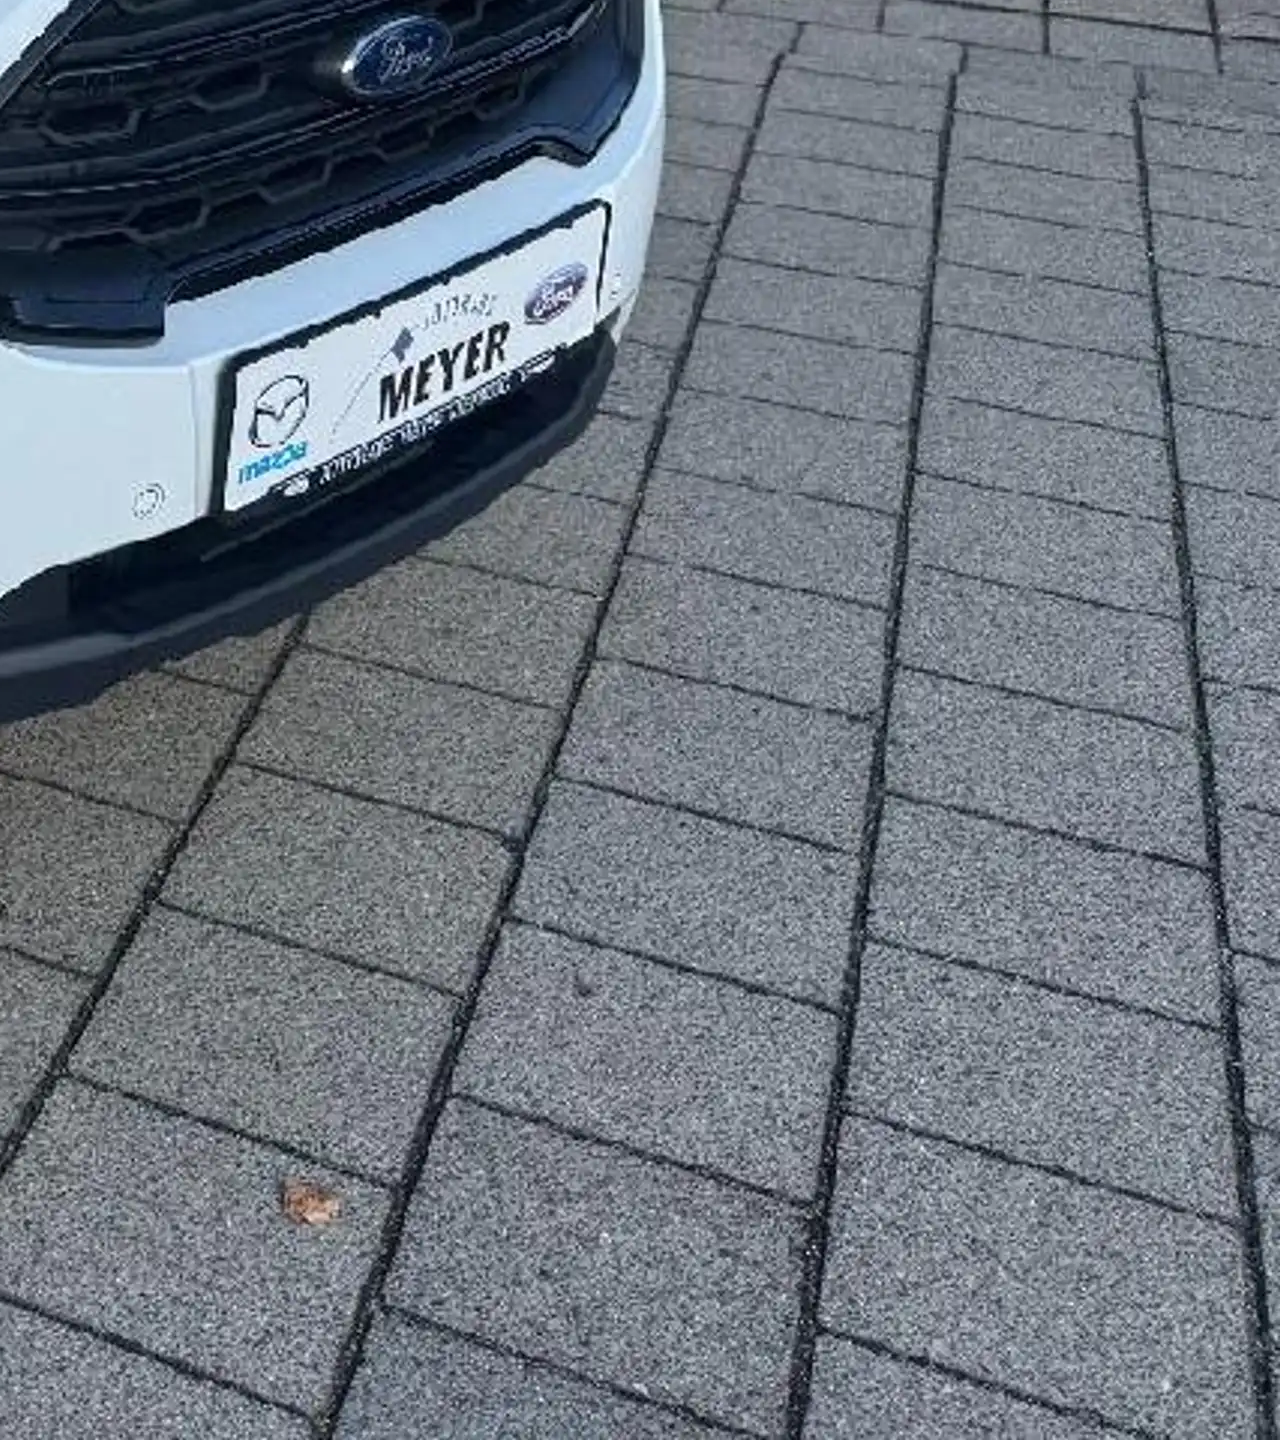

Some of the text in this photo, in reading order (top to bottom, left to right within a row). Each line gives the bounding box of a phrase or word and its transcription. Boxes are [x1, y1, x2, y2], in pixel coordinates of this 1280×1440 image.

[379, 34, 434, 85] Ford
[532, 275, 576, 317] Ford
[377, 320, 511, 423] MEYER
[238, 441, 308, 485] mazda
